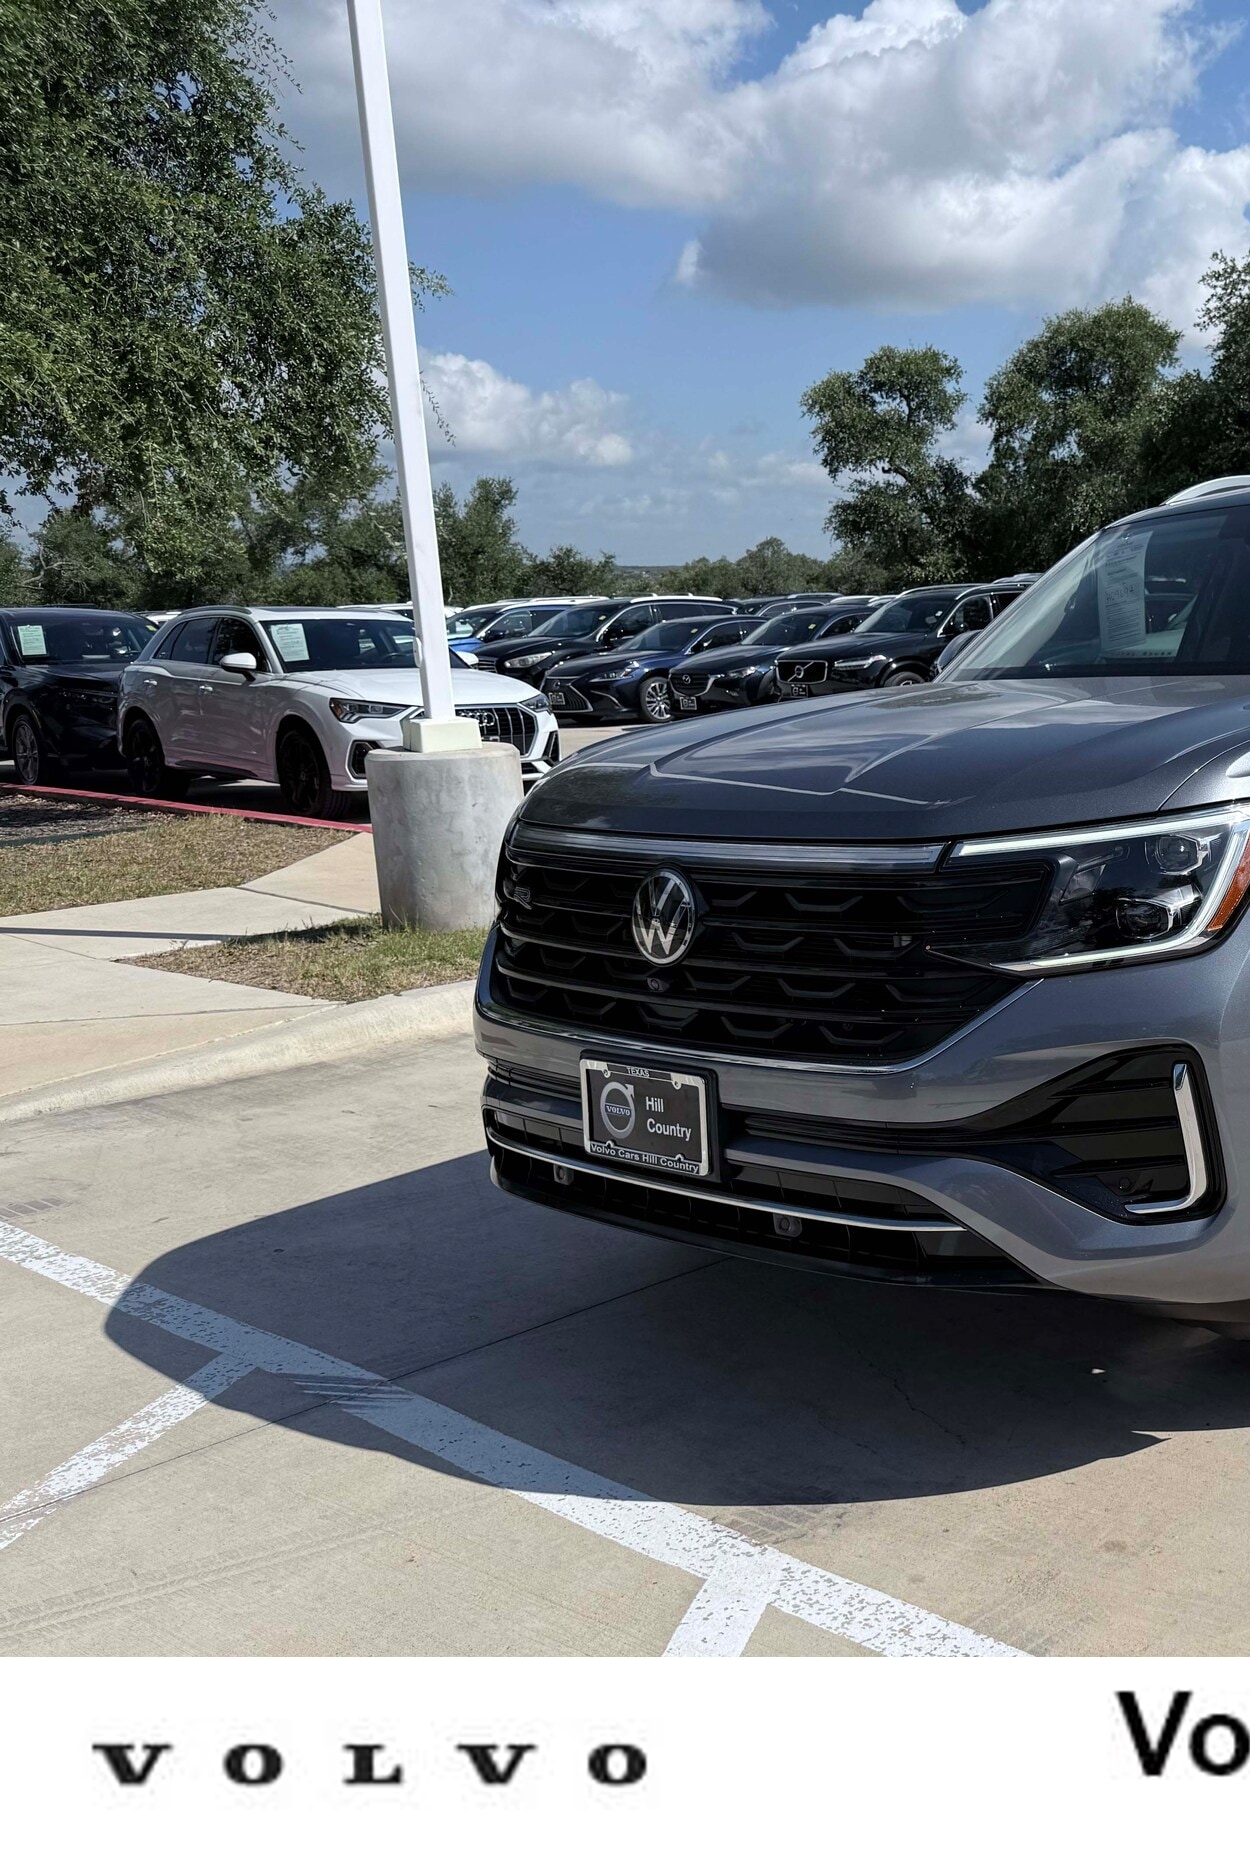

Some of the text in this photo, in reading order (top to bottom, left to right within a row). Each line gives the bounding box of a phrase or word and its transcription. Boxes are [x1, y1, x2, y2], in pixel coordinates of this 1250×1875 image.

[626, 1066, 650, 1077] TEXAS
[605, 1105, 631, 1116] VOLVO
[645, 1096, 664, 1113] Hill
[646, 1118, 692, 1142] Country
[590, 1143, 700, 1173] Volvo Cars Hill Country
